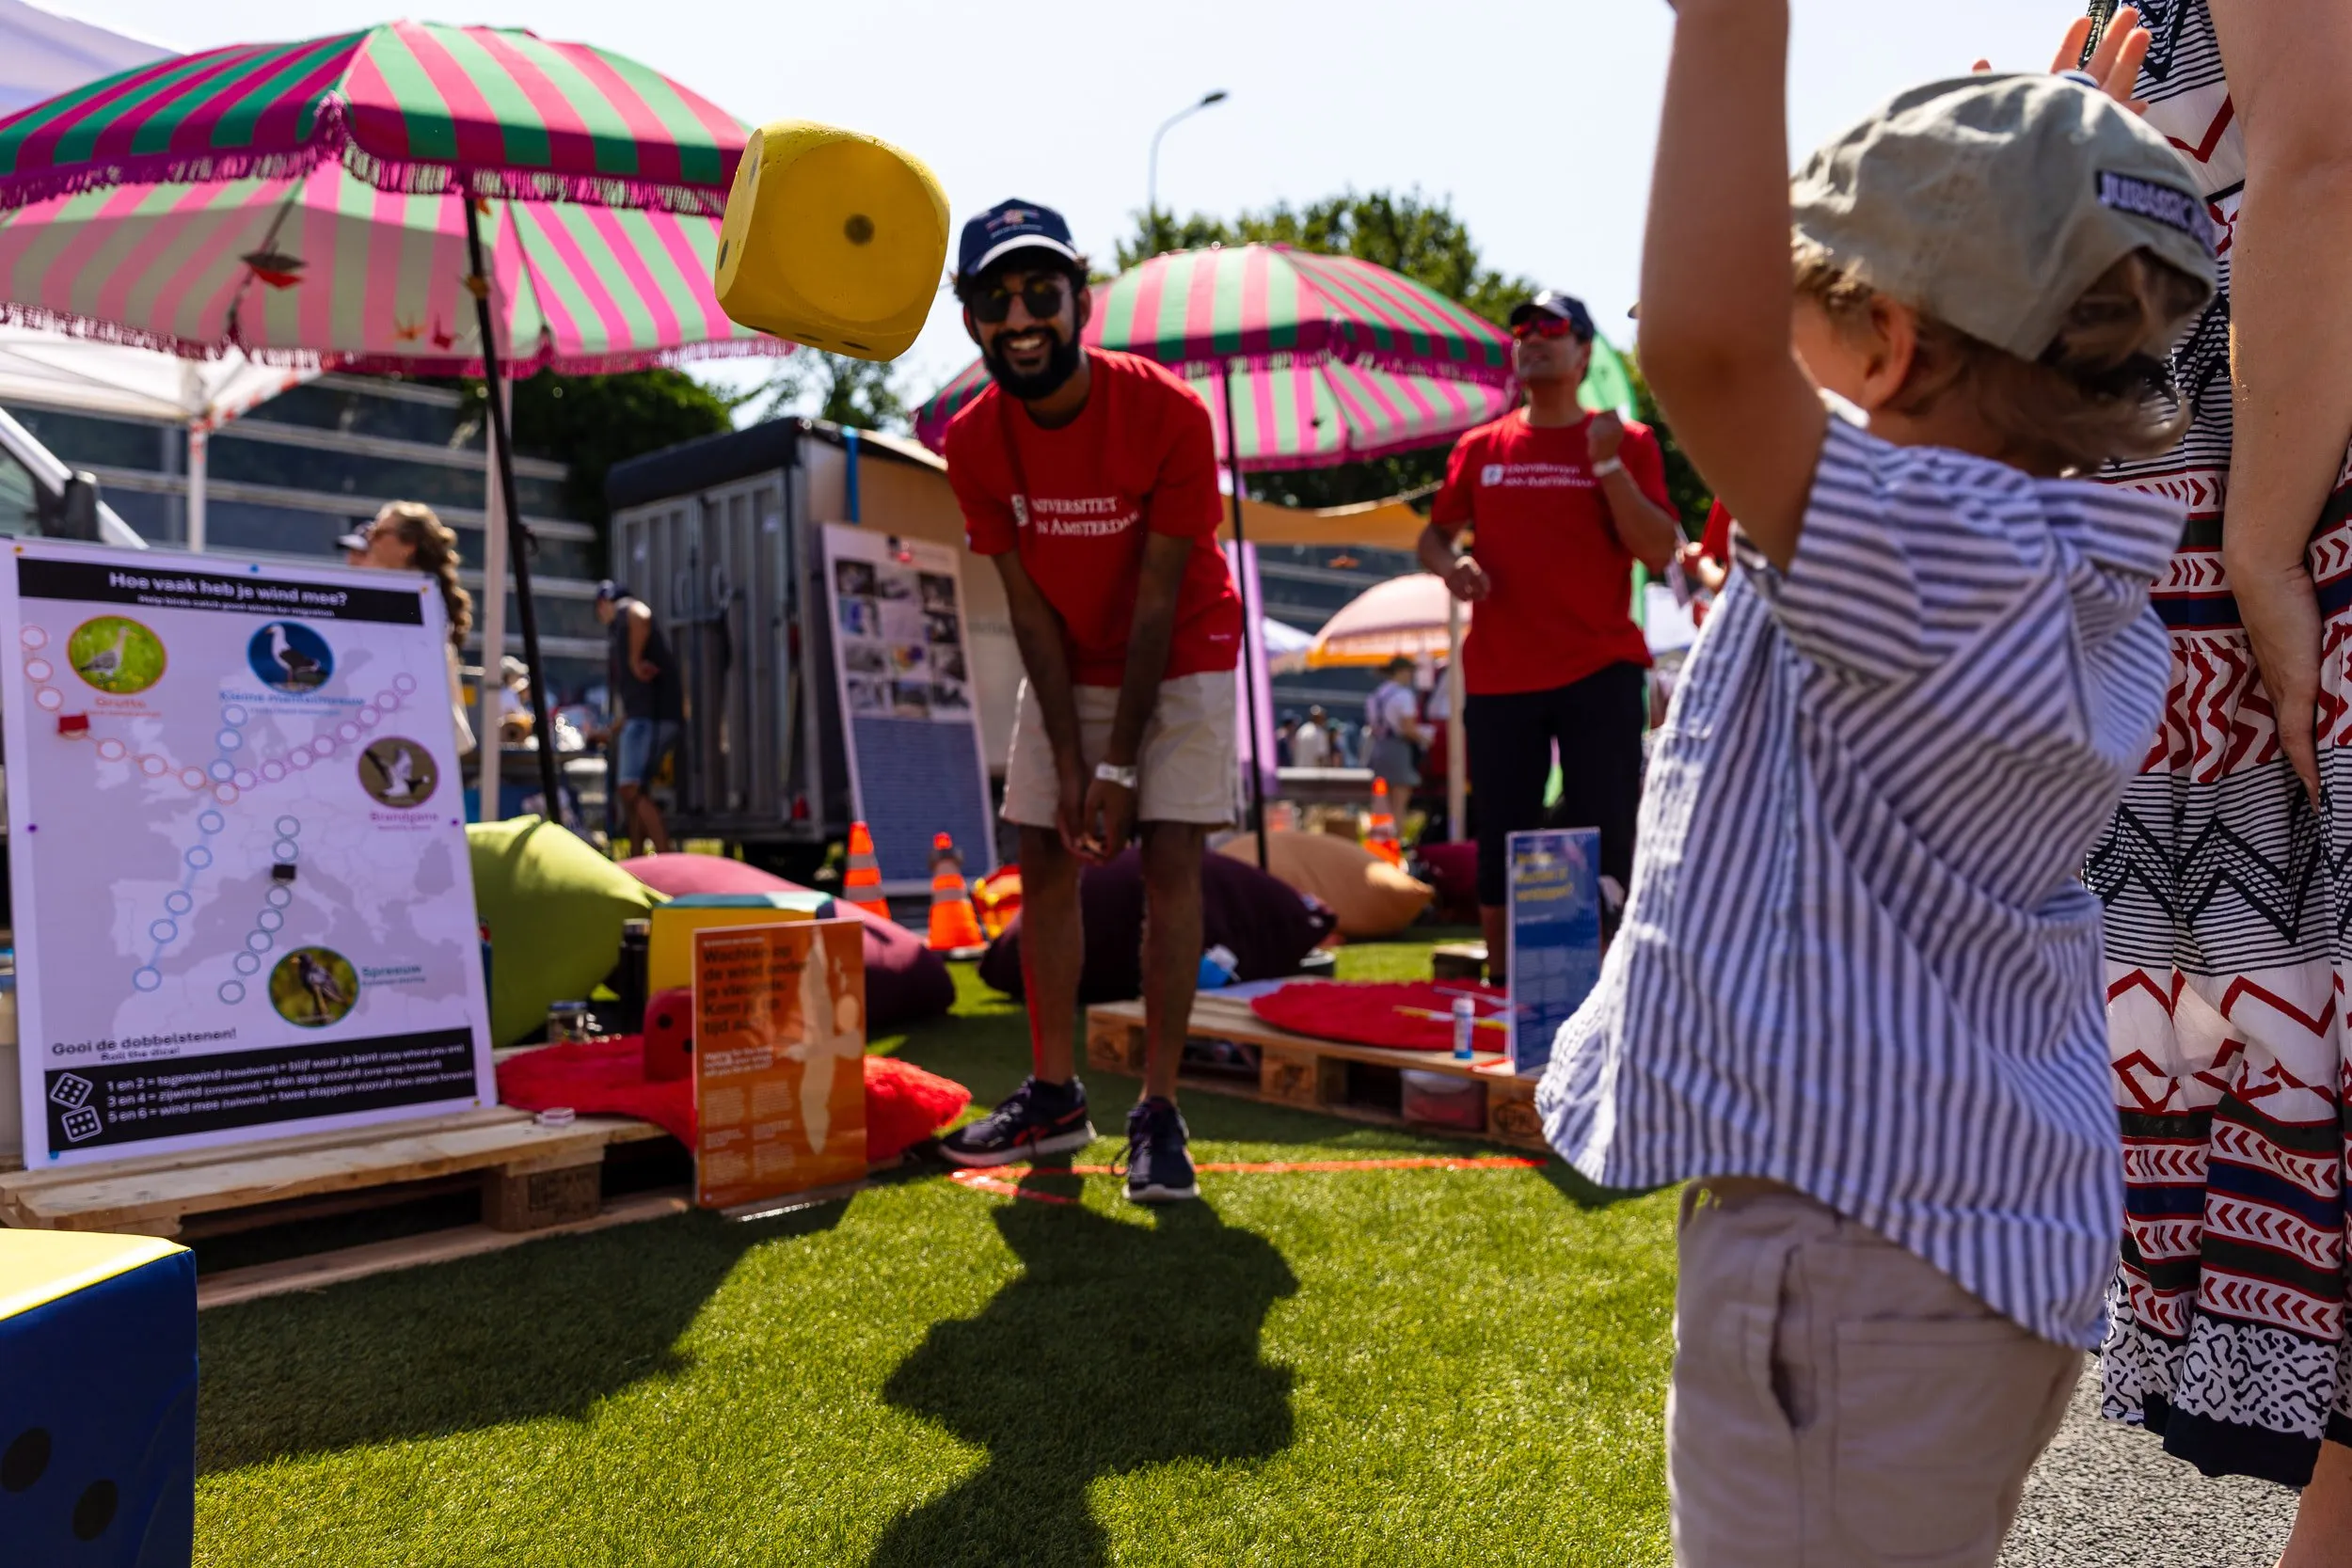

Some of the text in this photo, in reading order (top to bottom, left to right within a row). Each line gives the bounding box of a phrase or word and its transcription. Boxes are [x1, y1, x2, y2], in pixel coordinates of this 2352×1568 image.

[108, 571, 348, 607] Hoe vaak heb je wind mee?
[52, 1027, 237, 1056] Gooi de dobbelstenen!
[106, 1081, 115, 1092] 1
[117, 1080, 135, 1092] en
[135, 1077, 146, 1090] 2
[118, 1095, 136, 1107] en
[136, 1092, 147, 1104] 4
[119, 1110, 137, 1122] en
